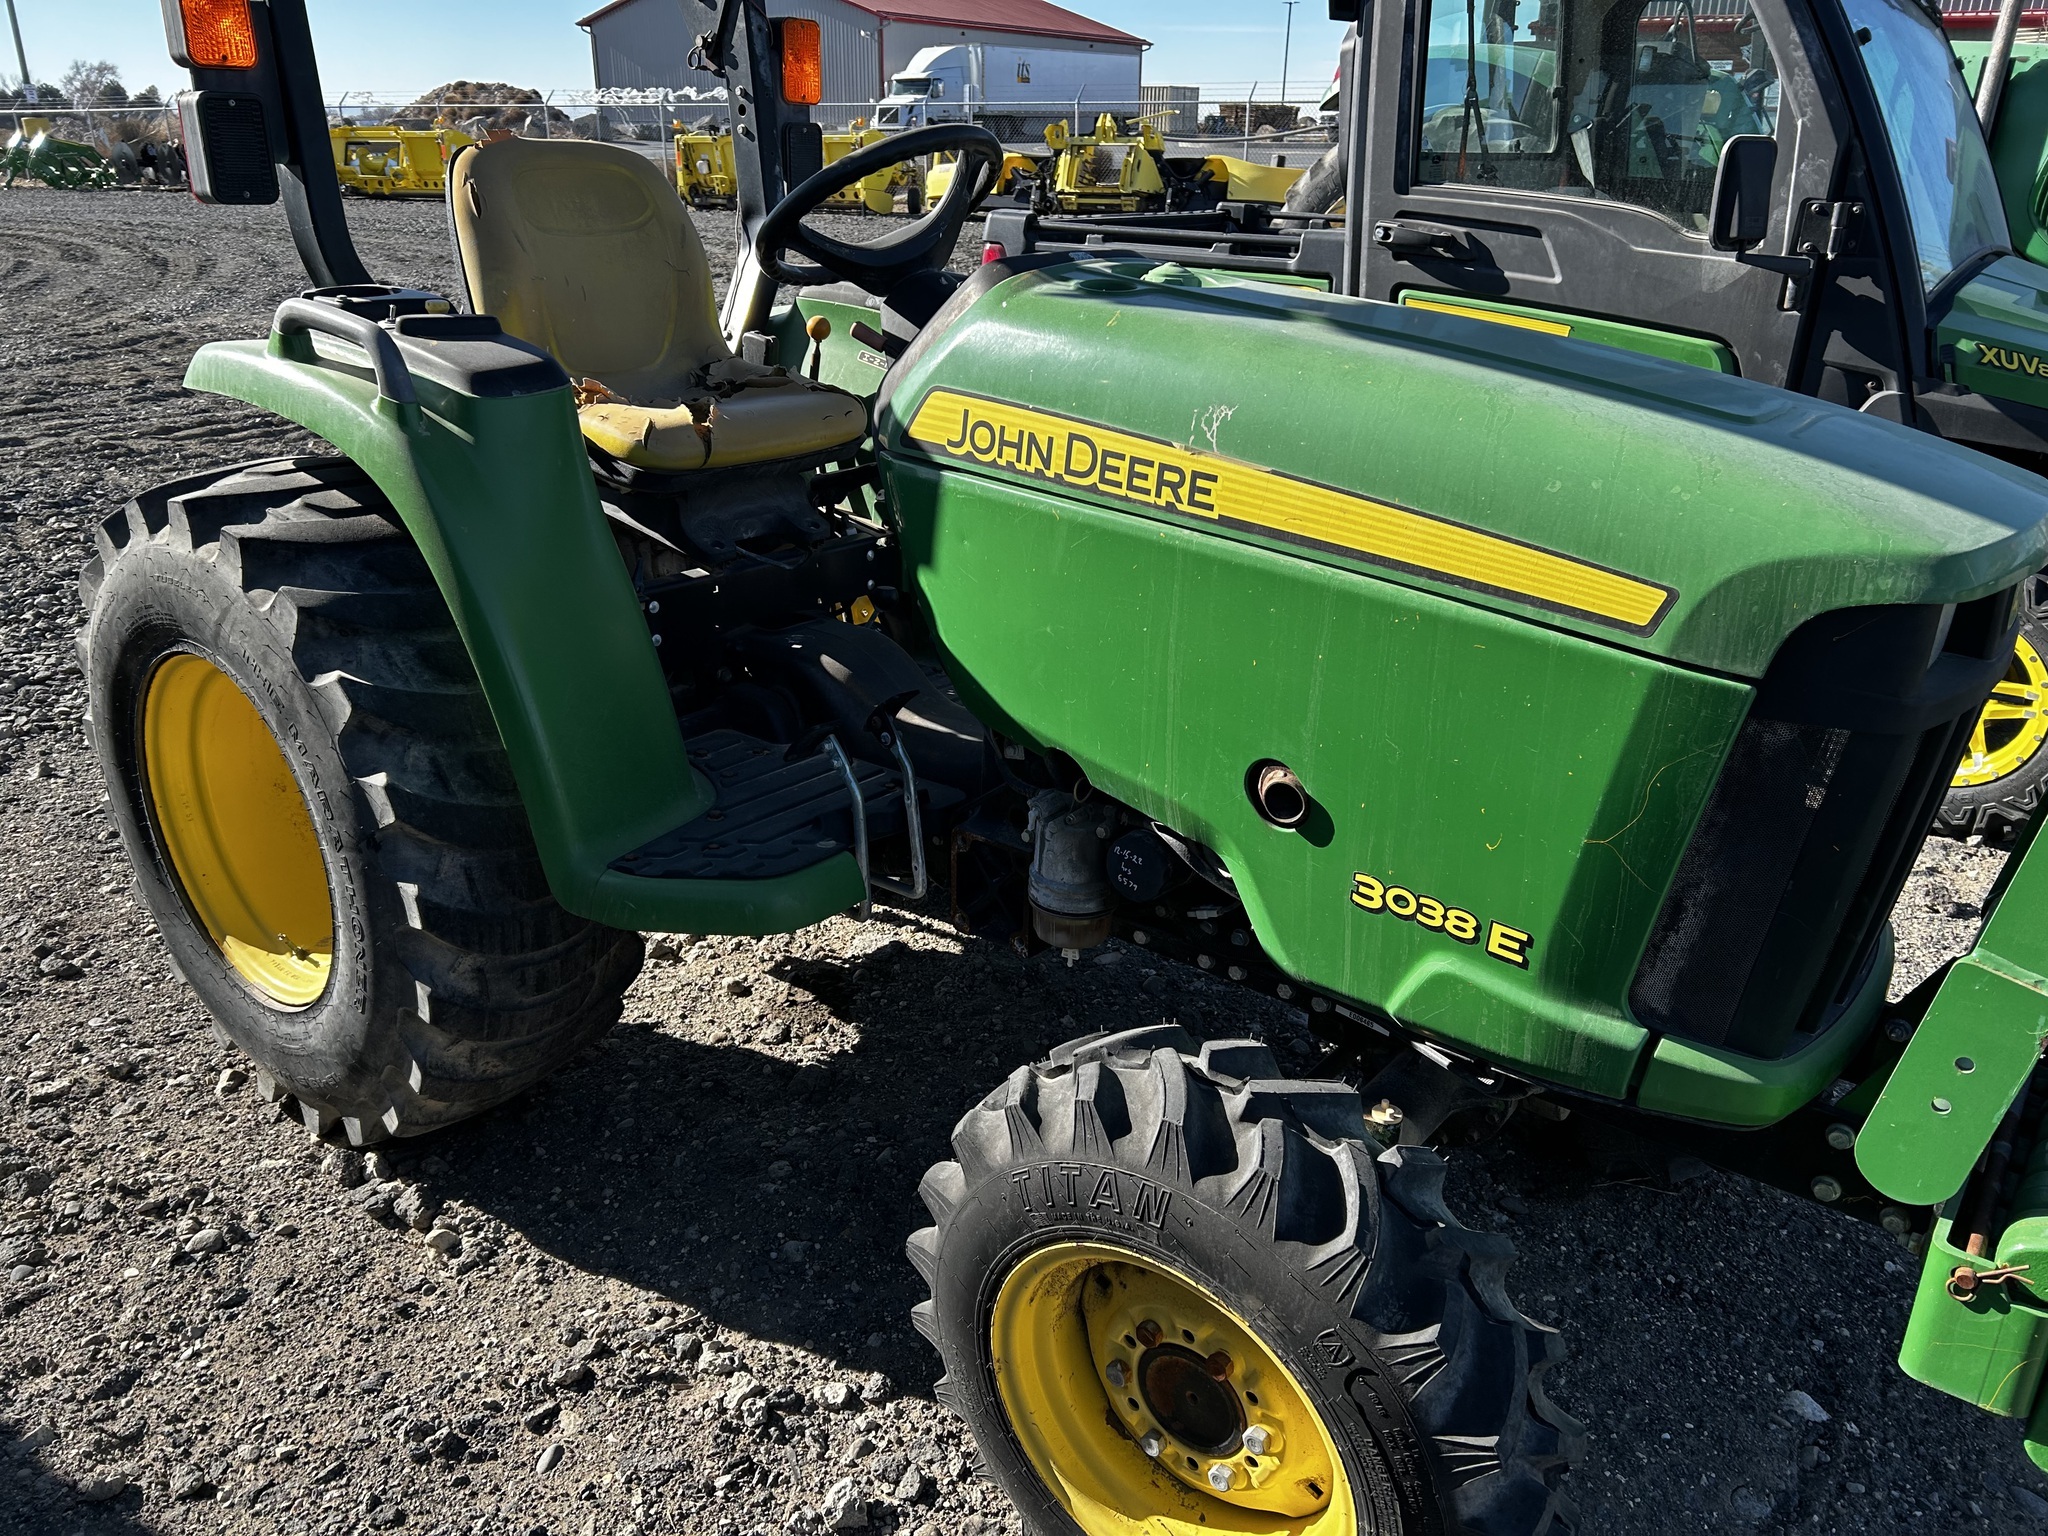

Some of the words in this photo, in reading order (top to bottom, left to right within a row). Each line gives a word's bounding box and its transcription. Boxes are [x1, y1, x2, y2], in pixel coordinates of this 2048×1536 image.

[946, 408, 1054, 471] JOHN
[1063, 431, 1219, 512] DEERE
[1351, 872, 1481, 944] 3038
[1486, 921, 1533, 968] E
[1011, 1163, 1172, 1230] TITAN
